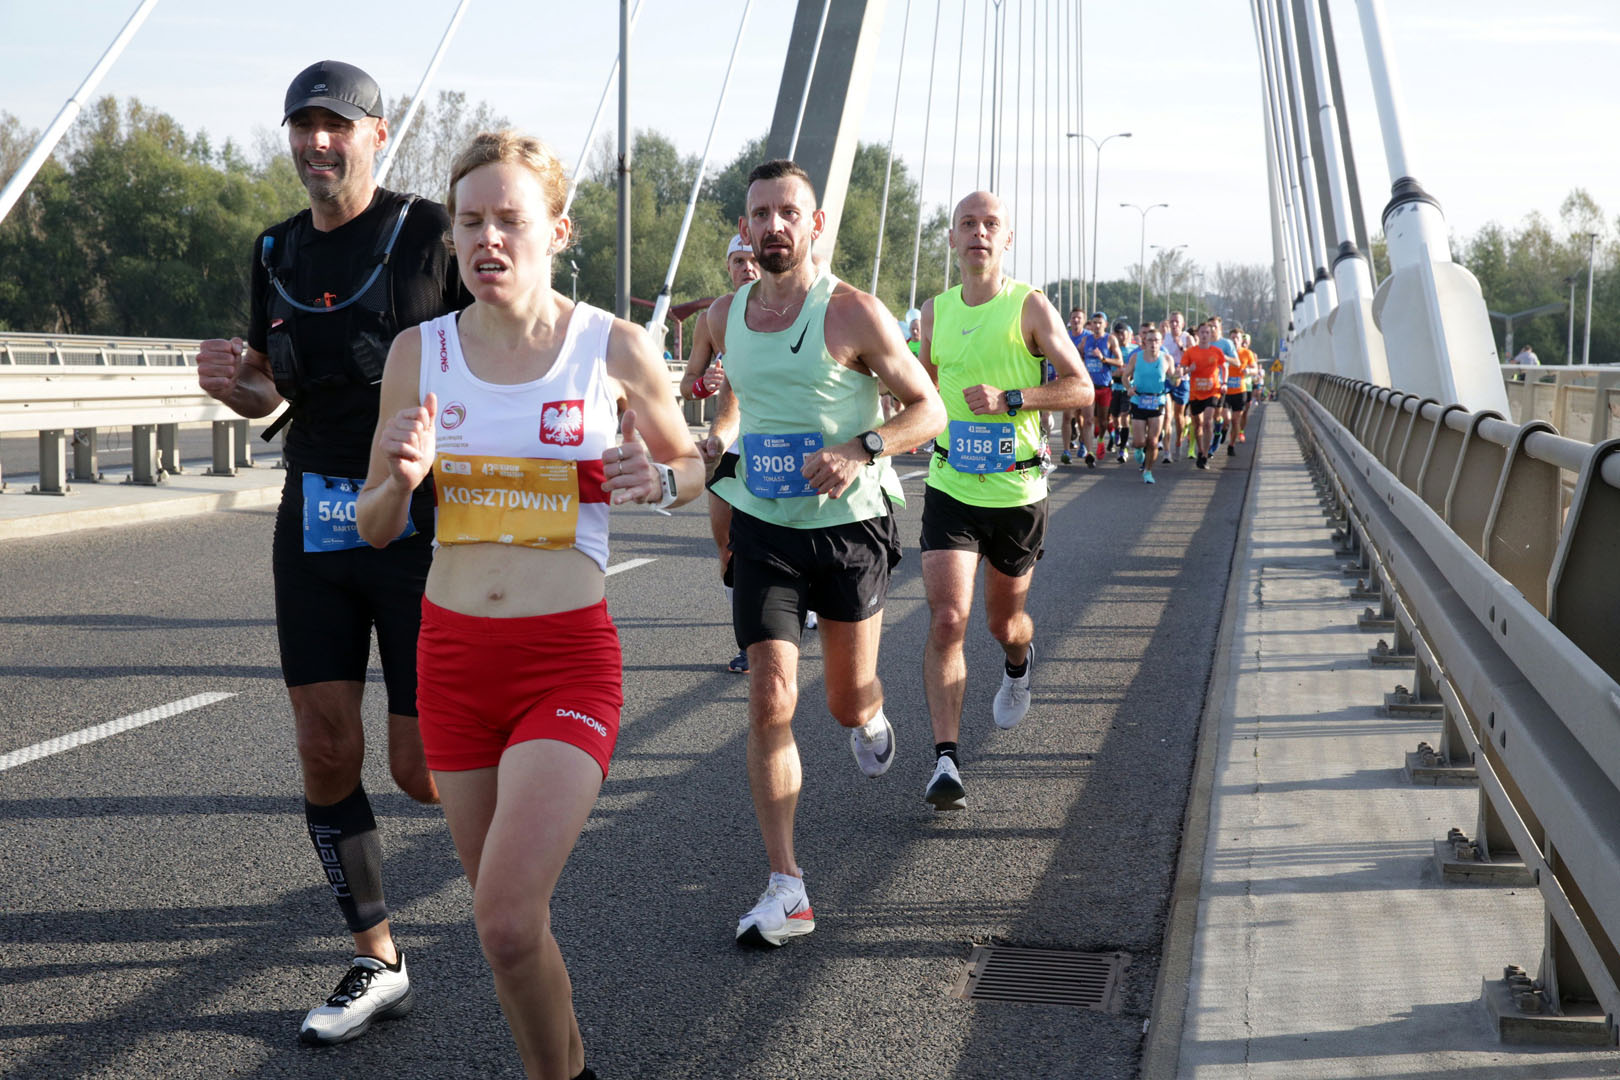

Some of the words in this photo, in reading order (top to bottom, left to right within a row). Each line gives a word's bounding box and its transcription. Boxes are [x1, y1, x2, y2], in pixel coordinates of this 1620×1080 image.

[438, 329, 449, 373] DAMONS
[957, 438, 992, 454] 3158
[753, 455, 795, 473] 3908
[443, 486, 572, 512] KOSZTOWNY
[556, 709, 607, 737] DAMONS
